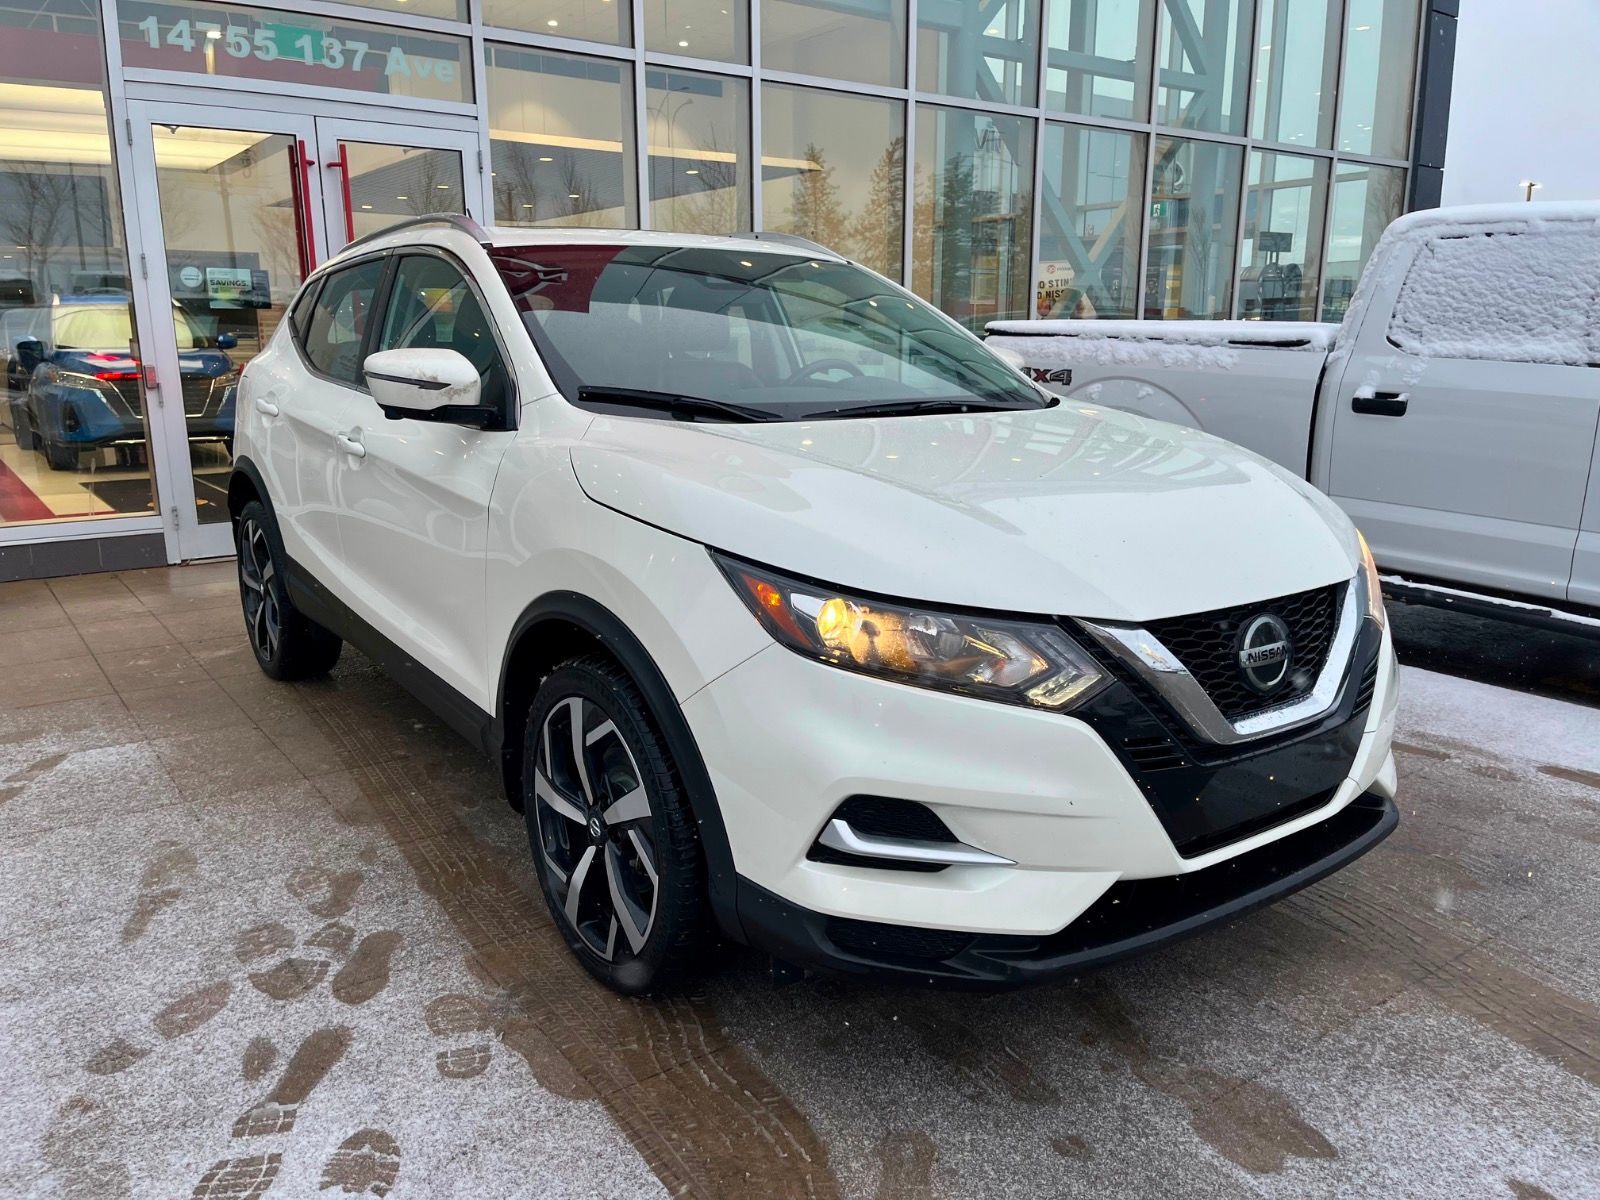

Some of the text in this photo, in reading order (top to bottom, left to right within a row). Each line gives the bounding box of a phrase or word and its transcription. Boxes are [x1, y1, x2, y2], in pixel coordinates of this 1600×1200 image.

[139, 15, 456, 82] 14755 137 Ave
[1248, 644, 1288, 664] NISSAN
